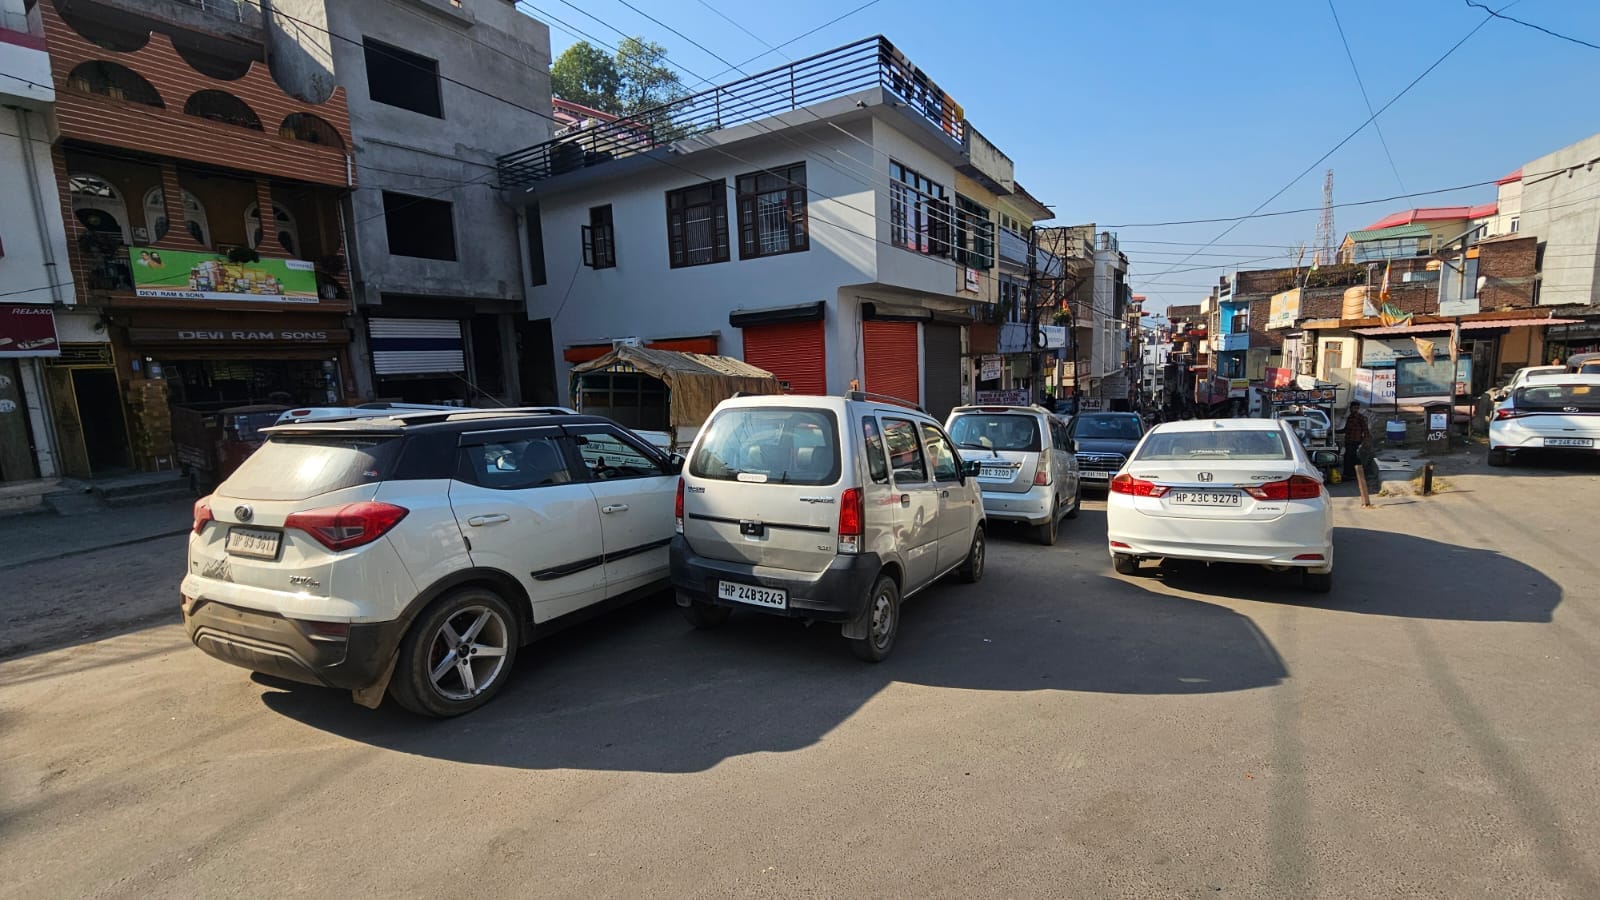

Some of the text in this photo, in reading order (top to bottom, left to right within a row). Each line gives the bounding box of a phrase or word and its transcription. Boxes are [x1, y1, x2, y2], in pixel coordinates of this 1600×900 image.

[178, 331, 328, 340] DEVI RAM SONS
[1176, 493, 1238, 504] HP 23C 9278
[725, 583, 784, 606] HP 24B3243
